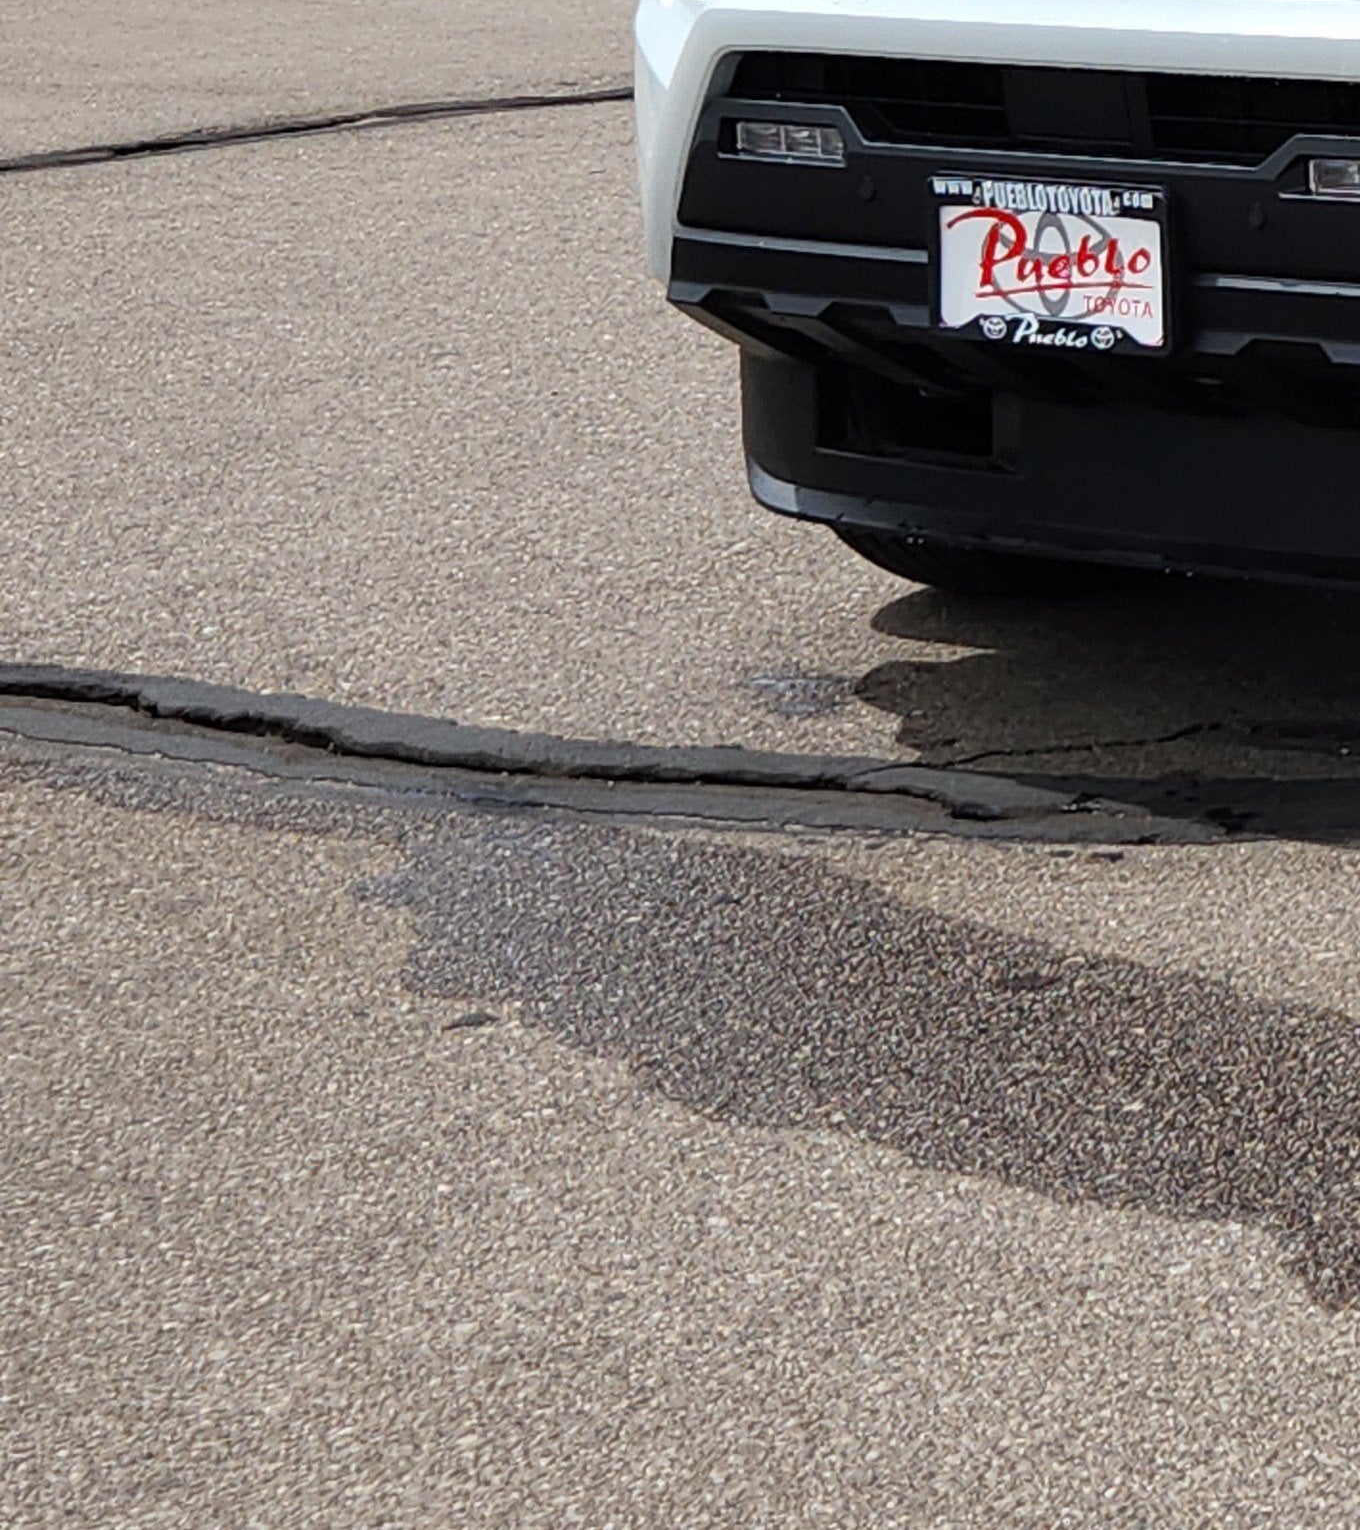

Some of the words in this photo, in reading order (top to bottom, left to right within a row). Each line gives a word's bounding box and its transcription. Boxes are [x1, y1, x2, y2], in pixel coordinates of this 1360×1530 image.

[946, 207, 1152, 288] Pueblo
[1083, 294, 1154, 319] TOYOTA
[1001, 312, 1088, 349] Pueblo
